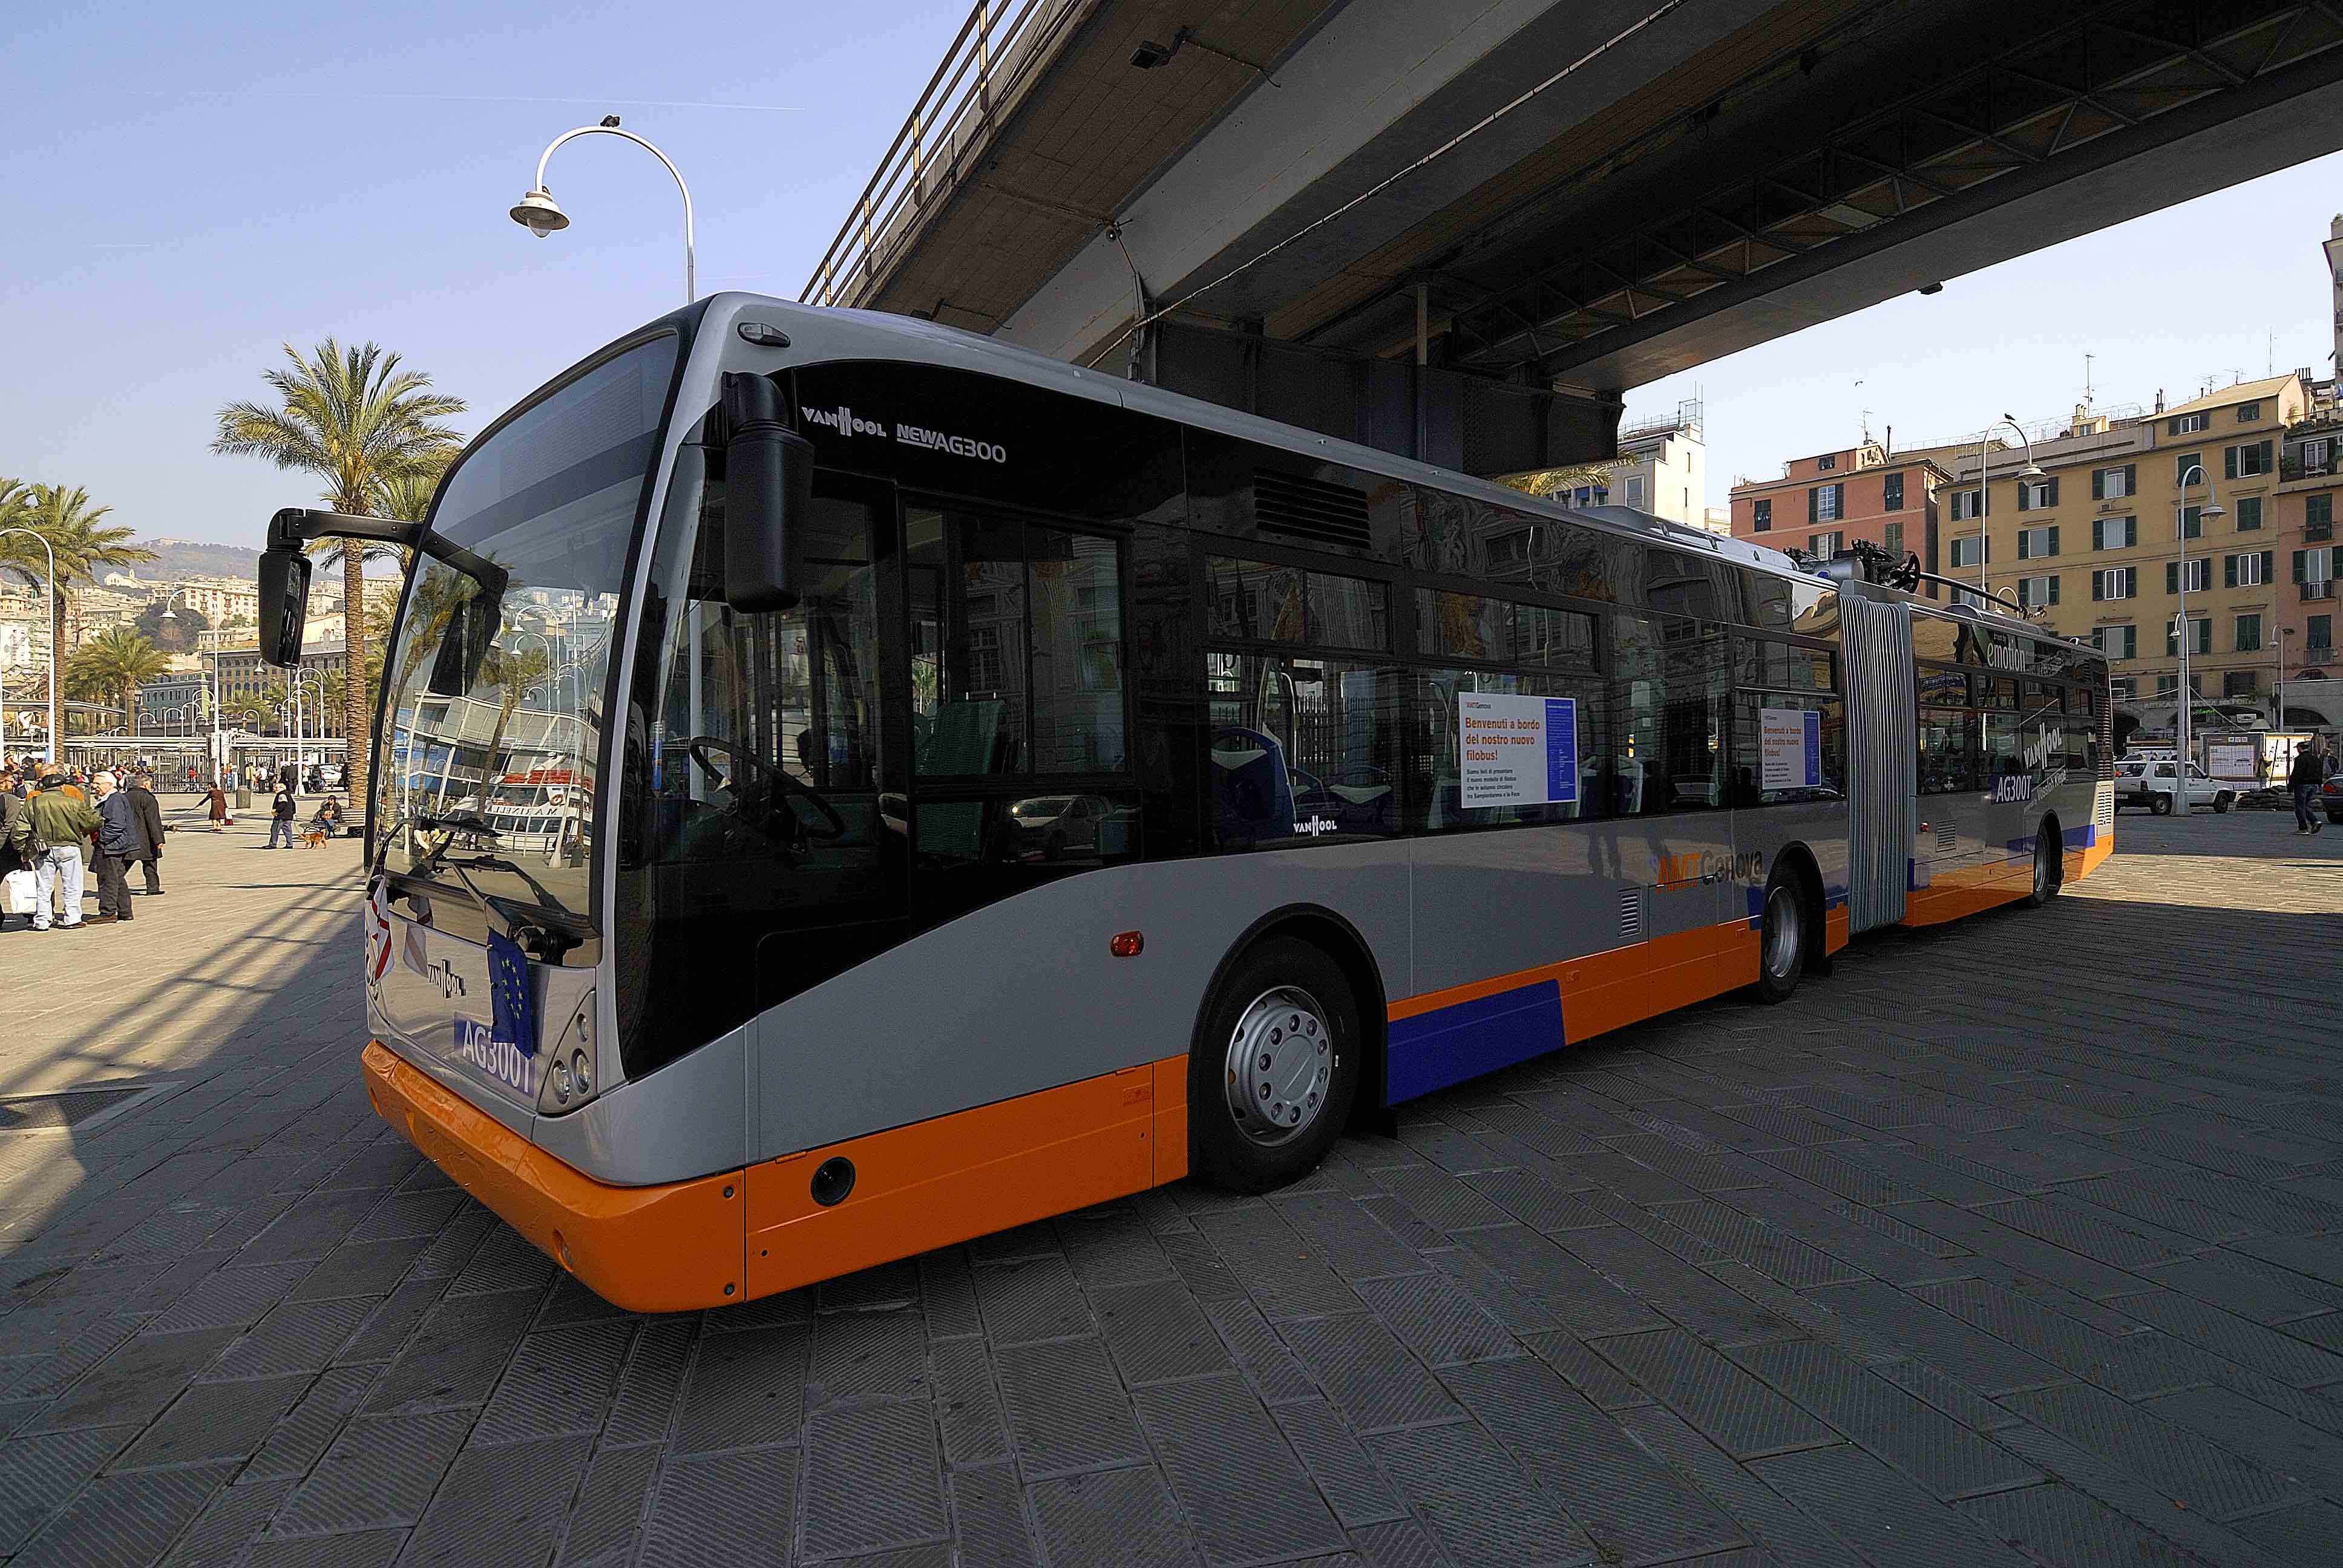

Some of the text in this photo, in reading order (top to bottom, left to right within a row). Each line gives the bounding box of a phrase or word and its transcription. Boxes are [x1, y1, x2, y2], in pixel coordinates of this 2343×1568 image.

[1987, 639, 2025, 672] emotion
[1465, 717, 1507, 729] Benvenuti
[1518, 719, 1540, 730] bordo
[1466, 734, 1535, 745] del nostro nuovo
[1466, 750, 1498, 760] filobus!
[1996, 776, 2032, 802] AG300T
